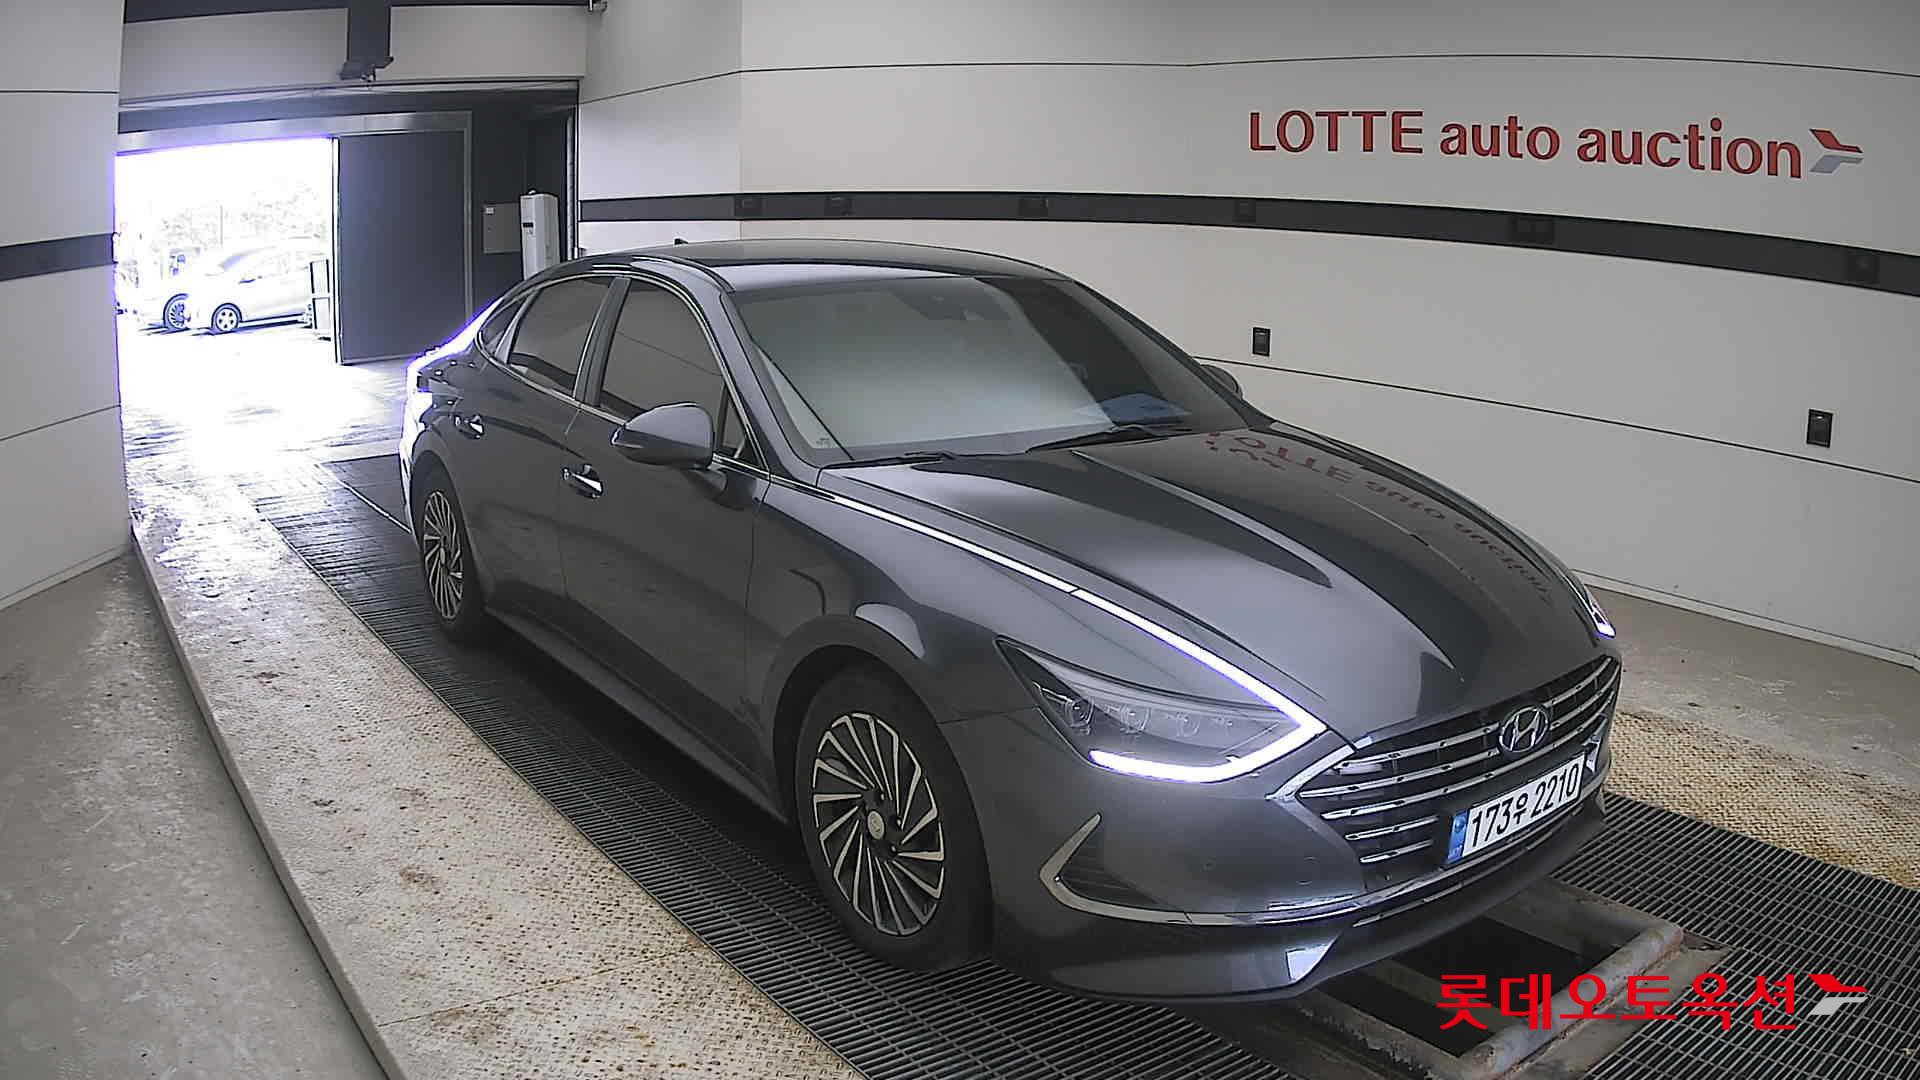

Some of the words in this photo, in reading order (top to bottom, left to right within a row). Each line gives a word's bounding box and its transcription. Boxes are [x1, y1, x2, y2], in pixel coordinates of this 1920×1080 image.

[1250, 110, 1424, 154] LOTTE
[1440, 116, 1561, 159] auto
[1577, 117, 1801, 178] auction
[1531, 763, 1579, 818] 2210
